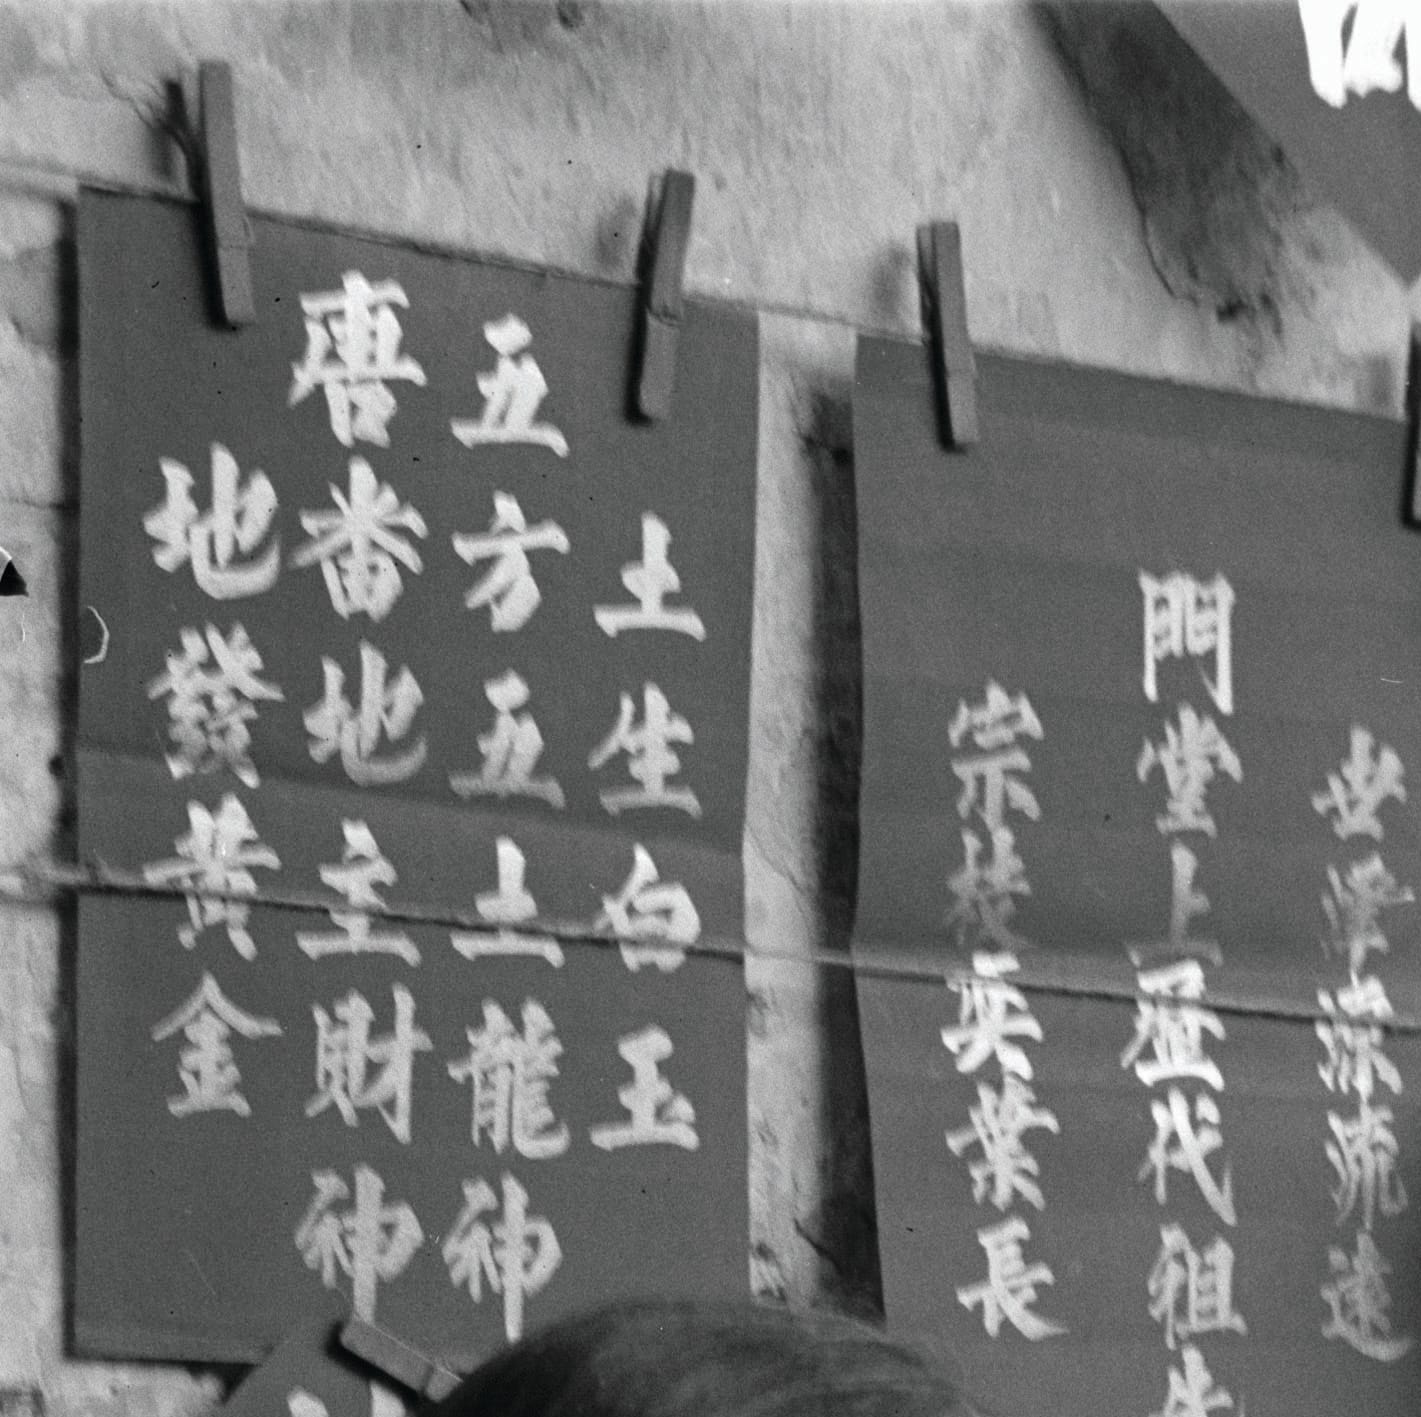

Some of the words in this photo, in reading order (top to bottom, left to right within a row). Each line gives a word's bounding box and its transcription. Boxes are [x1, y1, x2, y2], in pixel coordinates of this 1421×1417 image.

[443, 313, 571, 1344] 五方五土龍神
[589, 512, 706, 1153] 土生白玉
